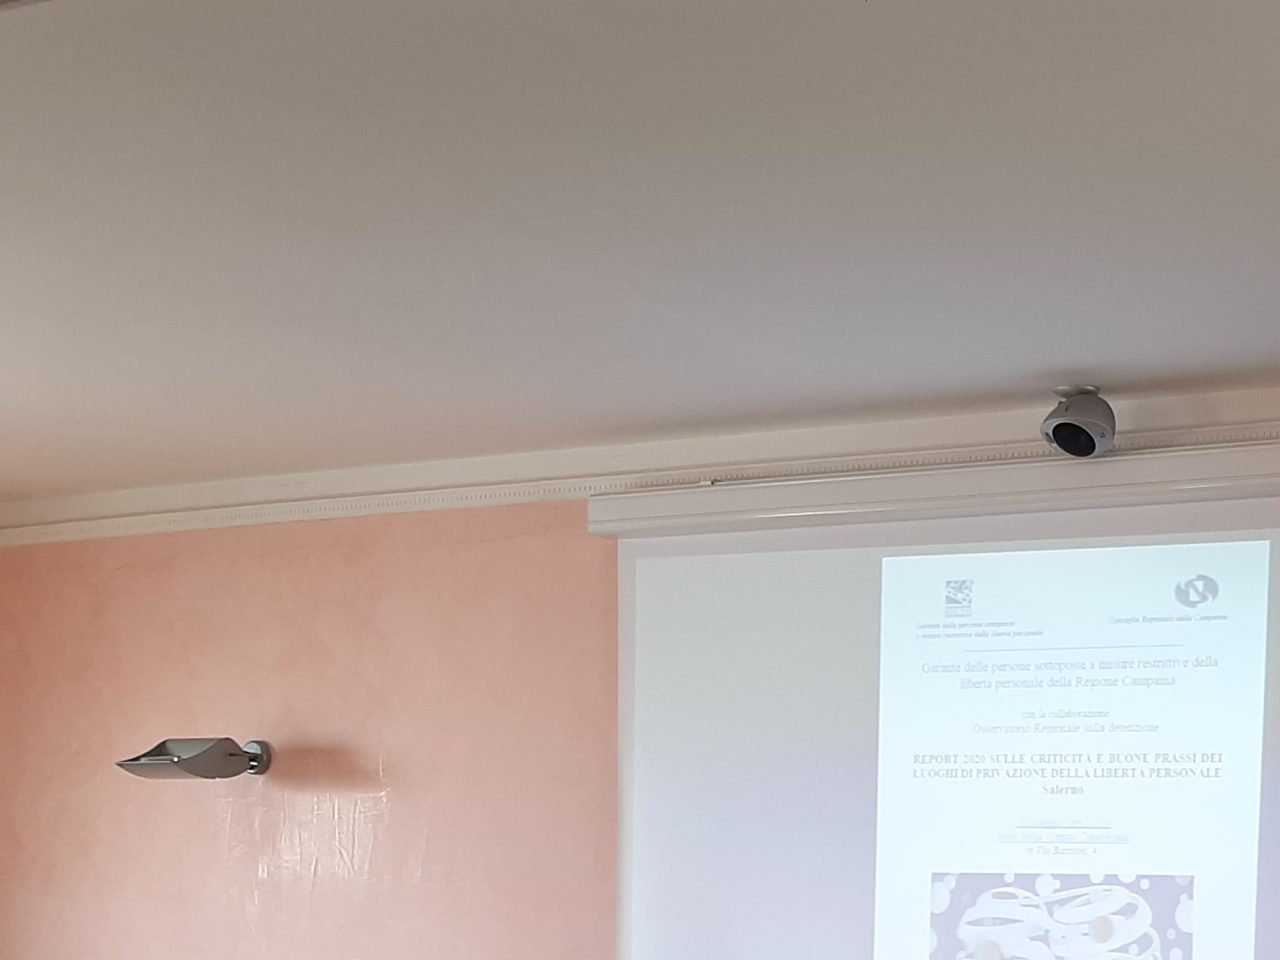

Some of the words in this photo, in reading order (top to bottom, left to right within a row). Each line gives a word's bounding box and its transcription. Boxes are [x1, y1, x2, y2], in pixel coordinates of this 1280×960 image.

[991, 663, 1032, 675] persone
[1192, 656, 1219, 668] della
[913, 753, 959, 764] REPORT
[990, 753, 1026, 764] SULLE
[1096, 753, 1105, 763] E
[1108, 753, 1150, 764] BUONE
[1154, 752, 1197, 763] PRASSI
[1201, 752, 1223, 763] DEI
[912, 768, 959, 779] LUOGHI
[961, 768, 973, 778] DI
[976, 767, 1048, 778] PRIVAZIONE
[1051, 767, 1090, 778] DELLA
[1149, 767, 1222, 778] PERSONALE
[1042, 785, 1085, 795] Salerno
